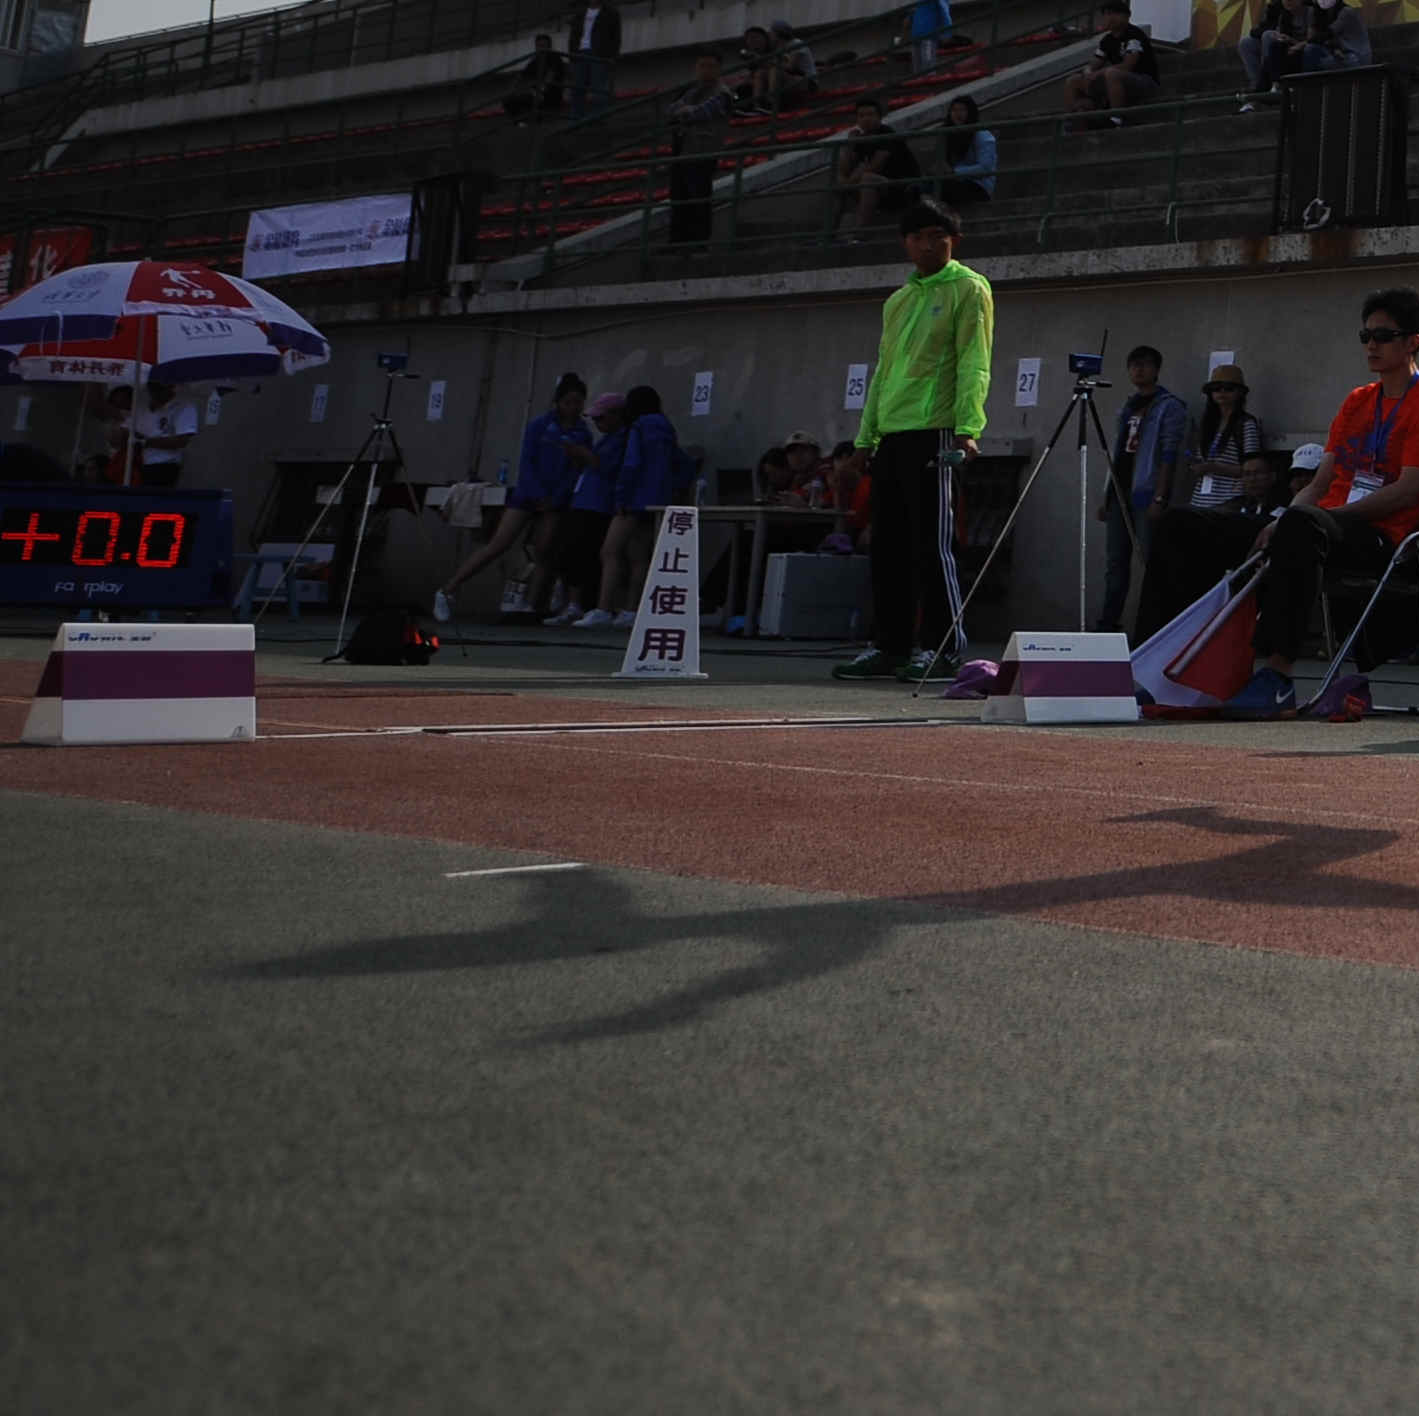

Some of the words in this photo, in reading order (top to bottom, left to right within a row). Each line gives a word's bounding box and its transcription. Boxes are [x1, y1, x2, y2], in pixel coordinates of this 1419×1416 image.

[848, 378, 863, 396] 25
[1019, 373, 1036, 393] 27
[695, 385, 708, 403] 23
[0, 511, 186, 569] +0.0
[638, 511, 695, 661] 停止使用
